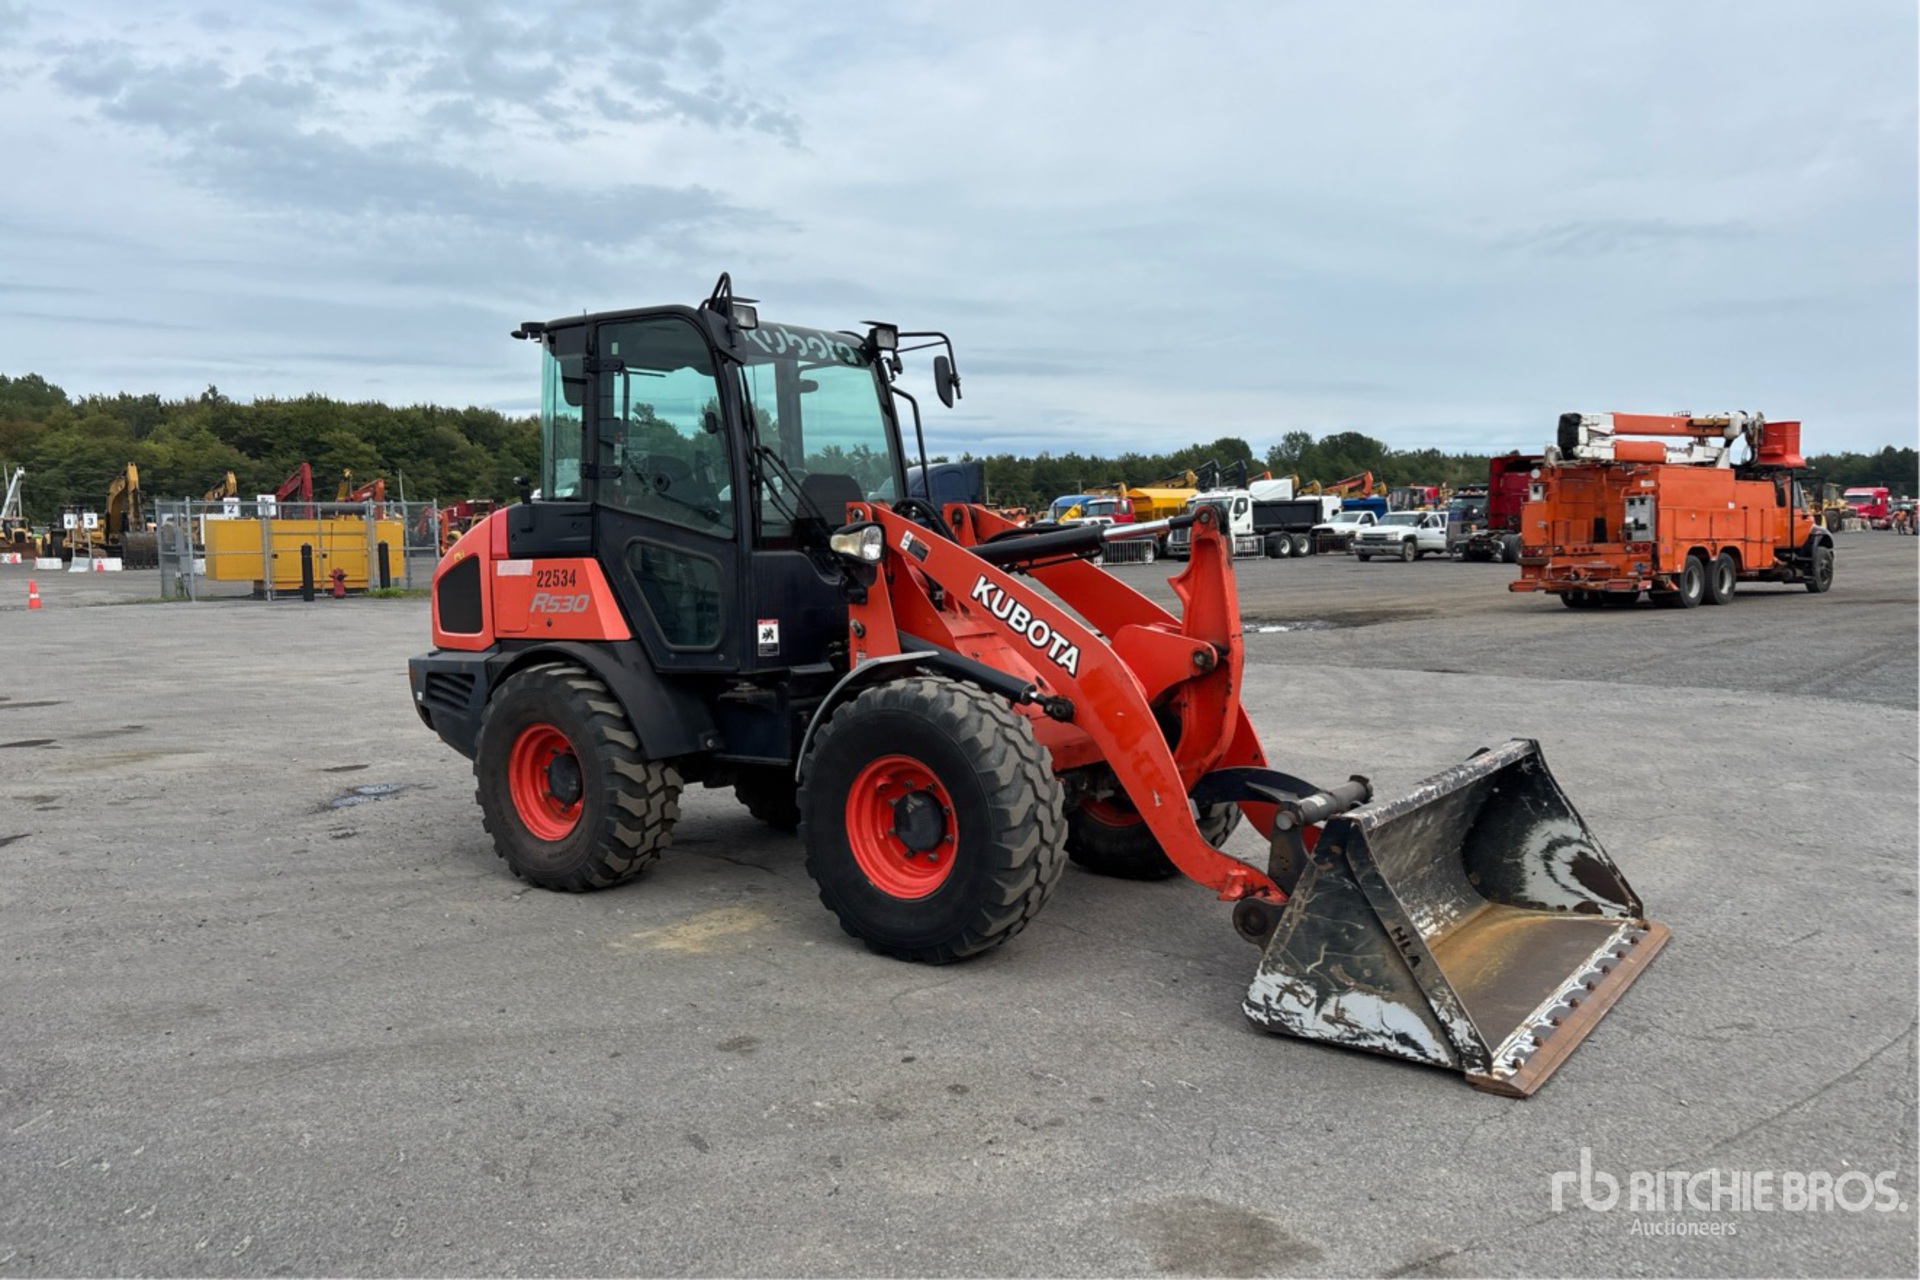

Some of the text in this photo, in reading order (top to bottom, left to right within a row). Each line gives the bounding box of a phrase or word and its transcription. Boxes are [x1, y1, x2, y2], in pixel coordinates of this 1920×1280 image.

[537, 569, 576, 587] 22534
[529, 593, 590, 613] R530
[970, 574, 1080, 677] KUBOTA
[1391, 926, 1421, 969] HLA
